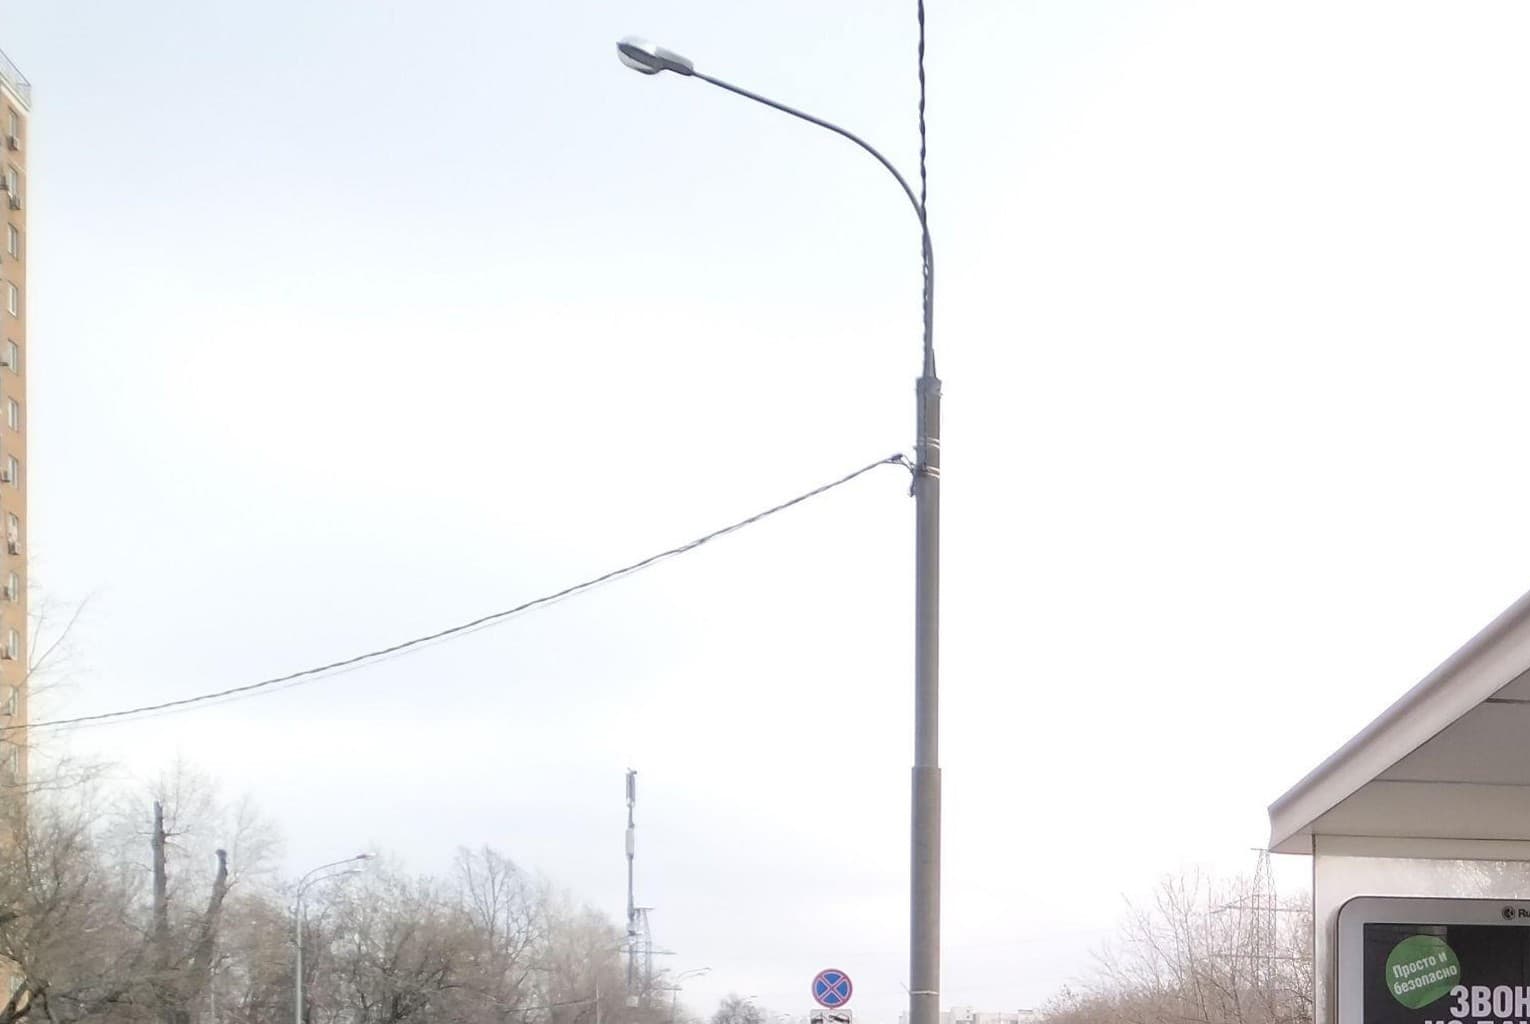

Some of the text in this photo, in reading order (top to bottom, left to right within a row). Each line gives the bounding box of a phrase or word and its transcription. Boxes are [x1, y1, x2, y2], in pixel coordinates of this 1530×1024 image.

[1392, 951, 1448, 979] Просто и
[1393, 964, 1458, 995] безопасно
